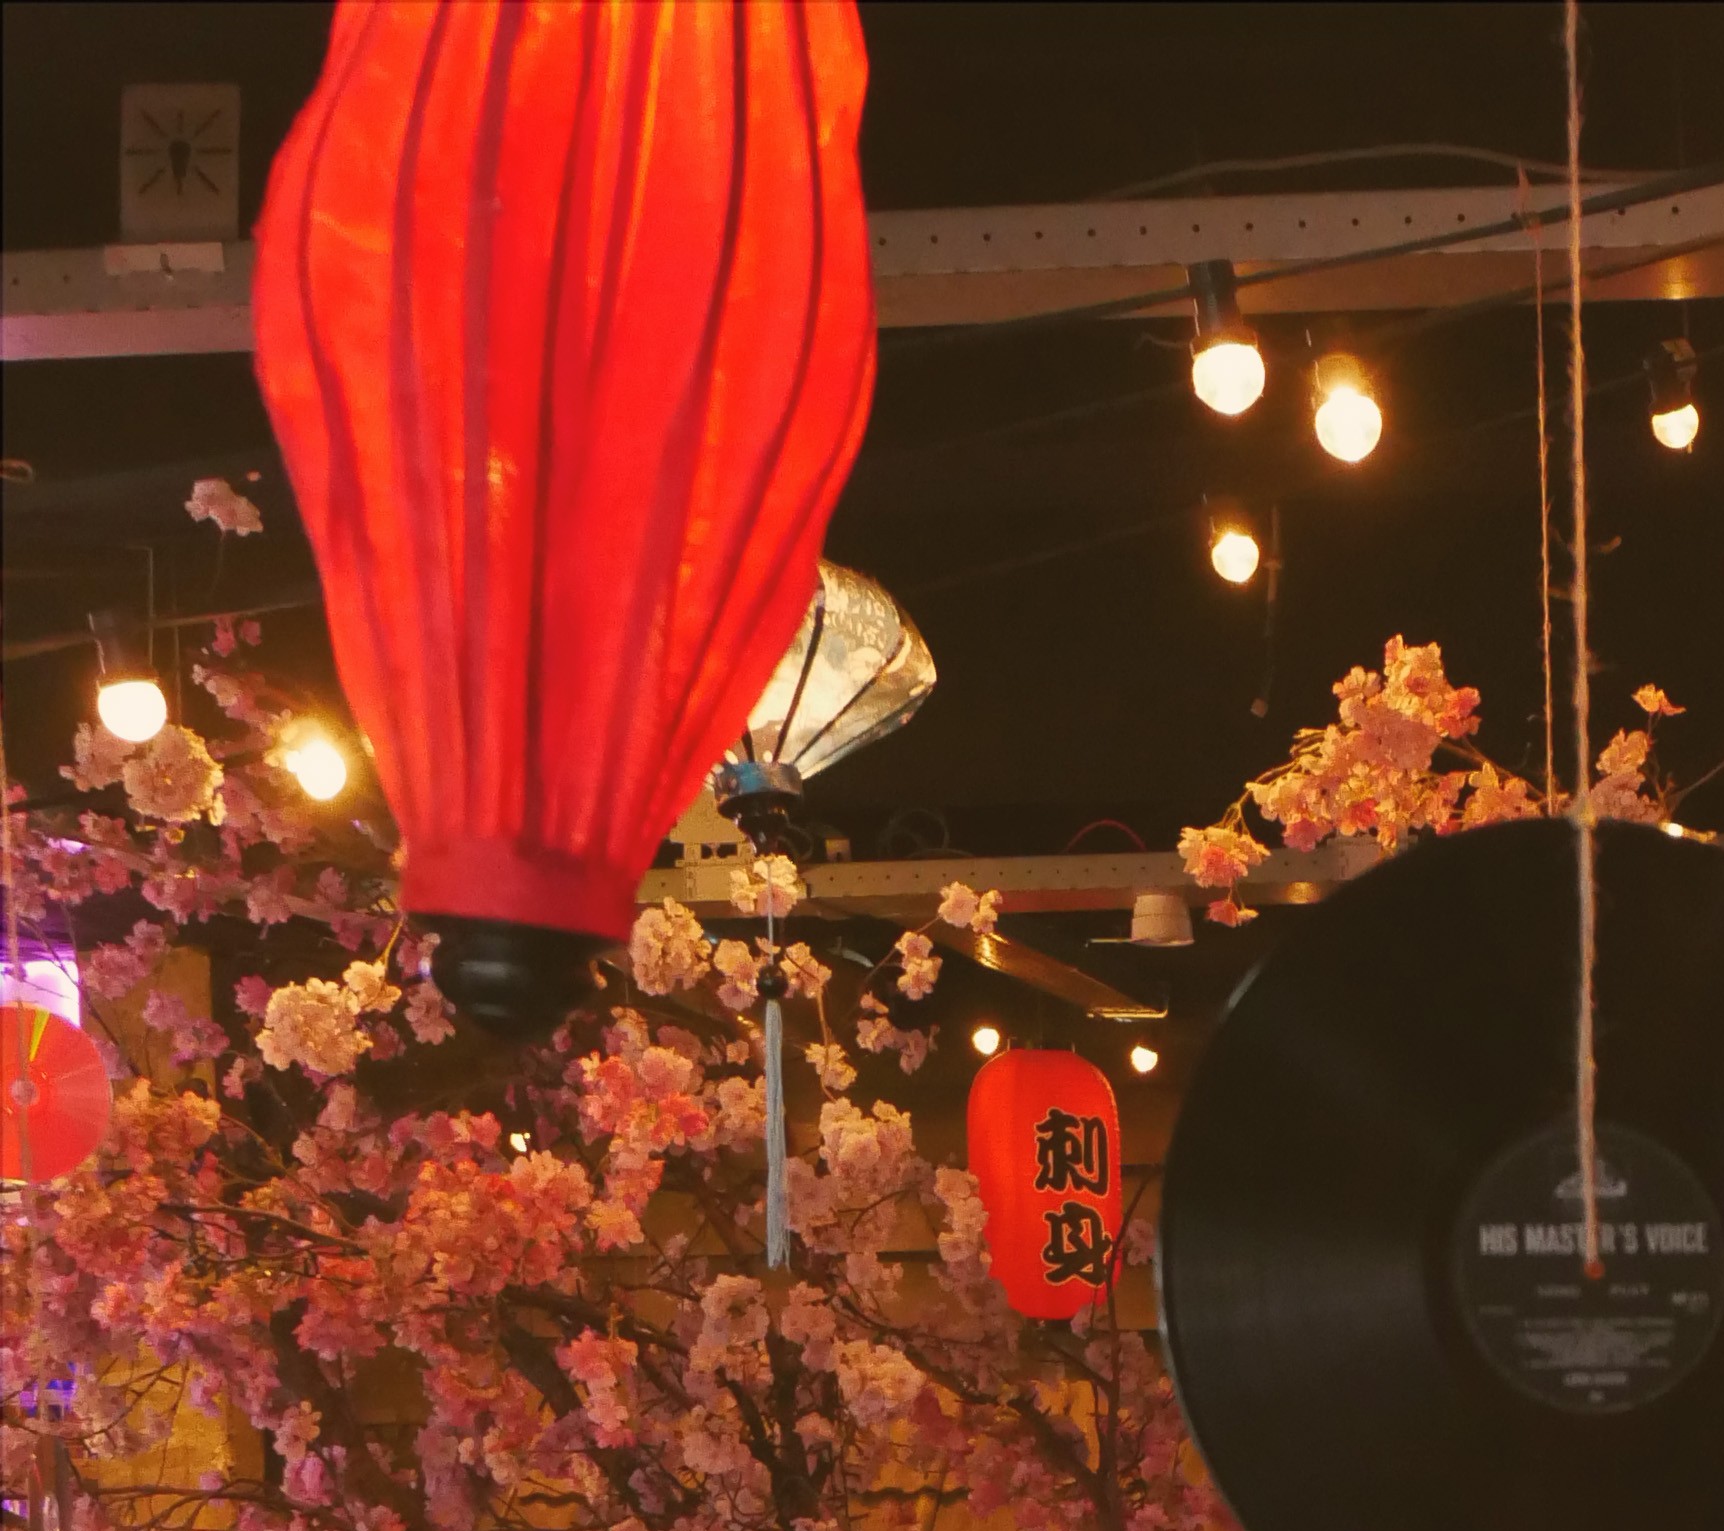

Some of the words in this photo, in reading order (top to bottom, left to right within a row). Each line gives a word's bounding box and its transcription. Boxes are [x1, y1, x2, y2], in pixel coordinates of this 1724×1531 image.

[1479, 1223, 1518, 1256] HIS
[1524, 1222, 1639, 1255] MASTR'S
[1646, 1221, 1708, 1254] VOICE
